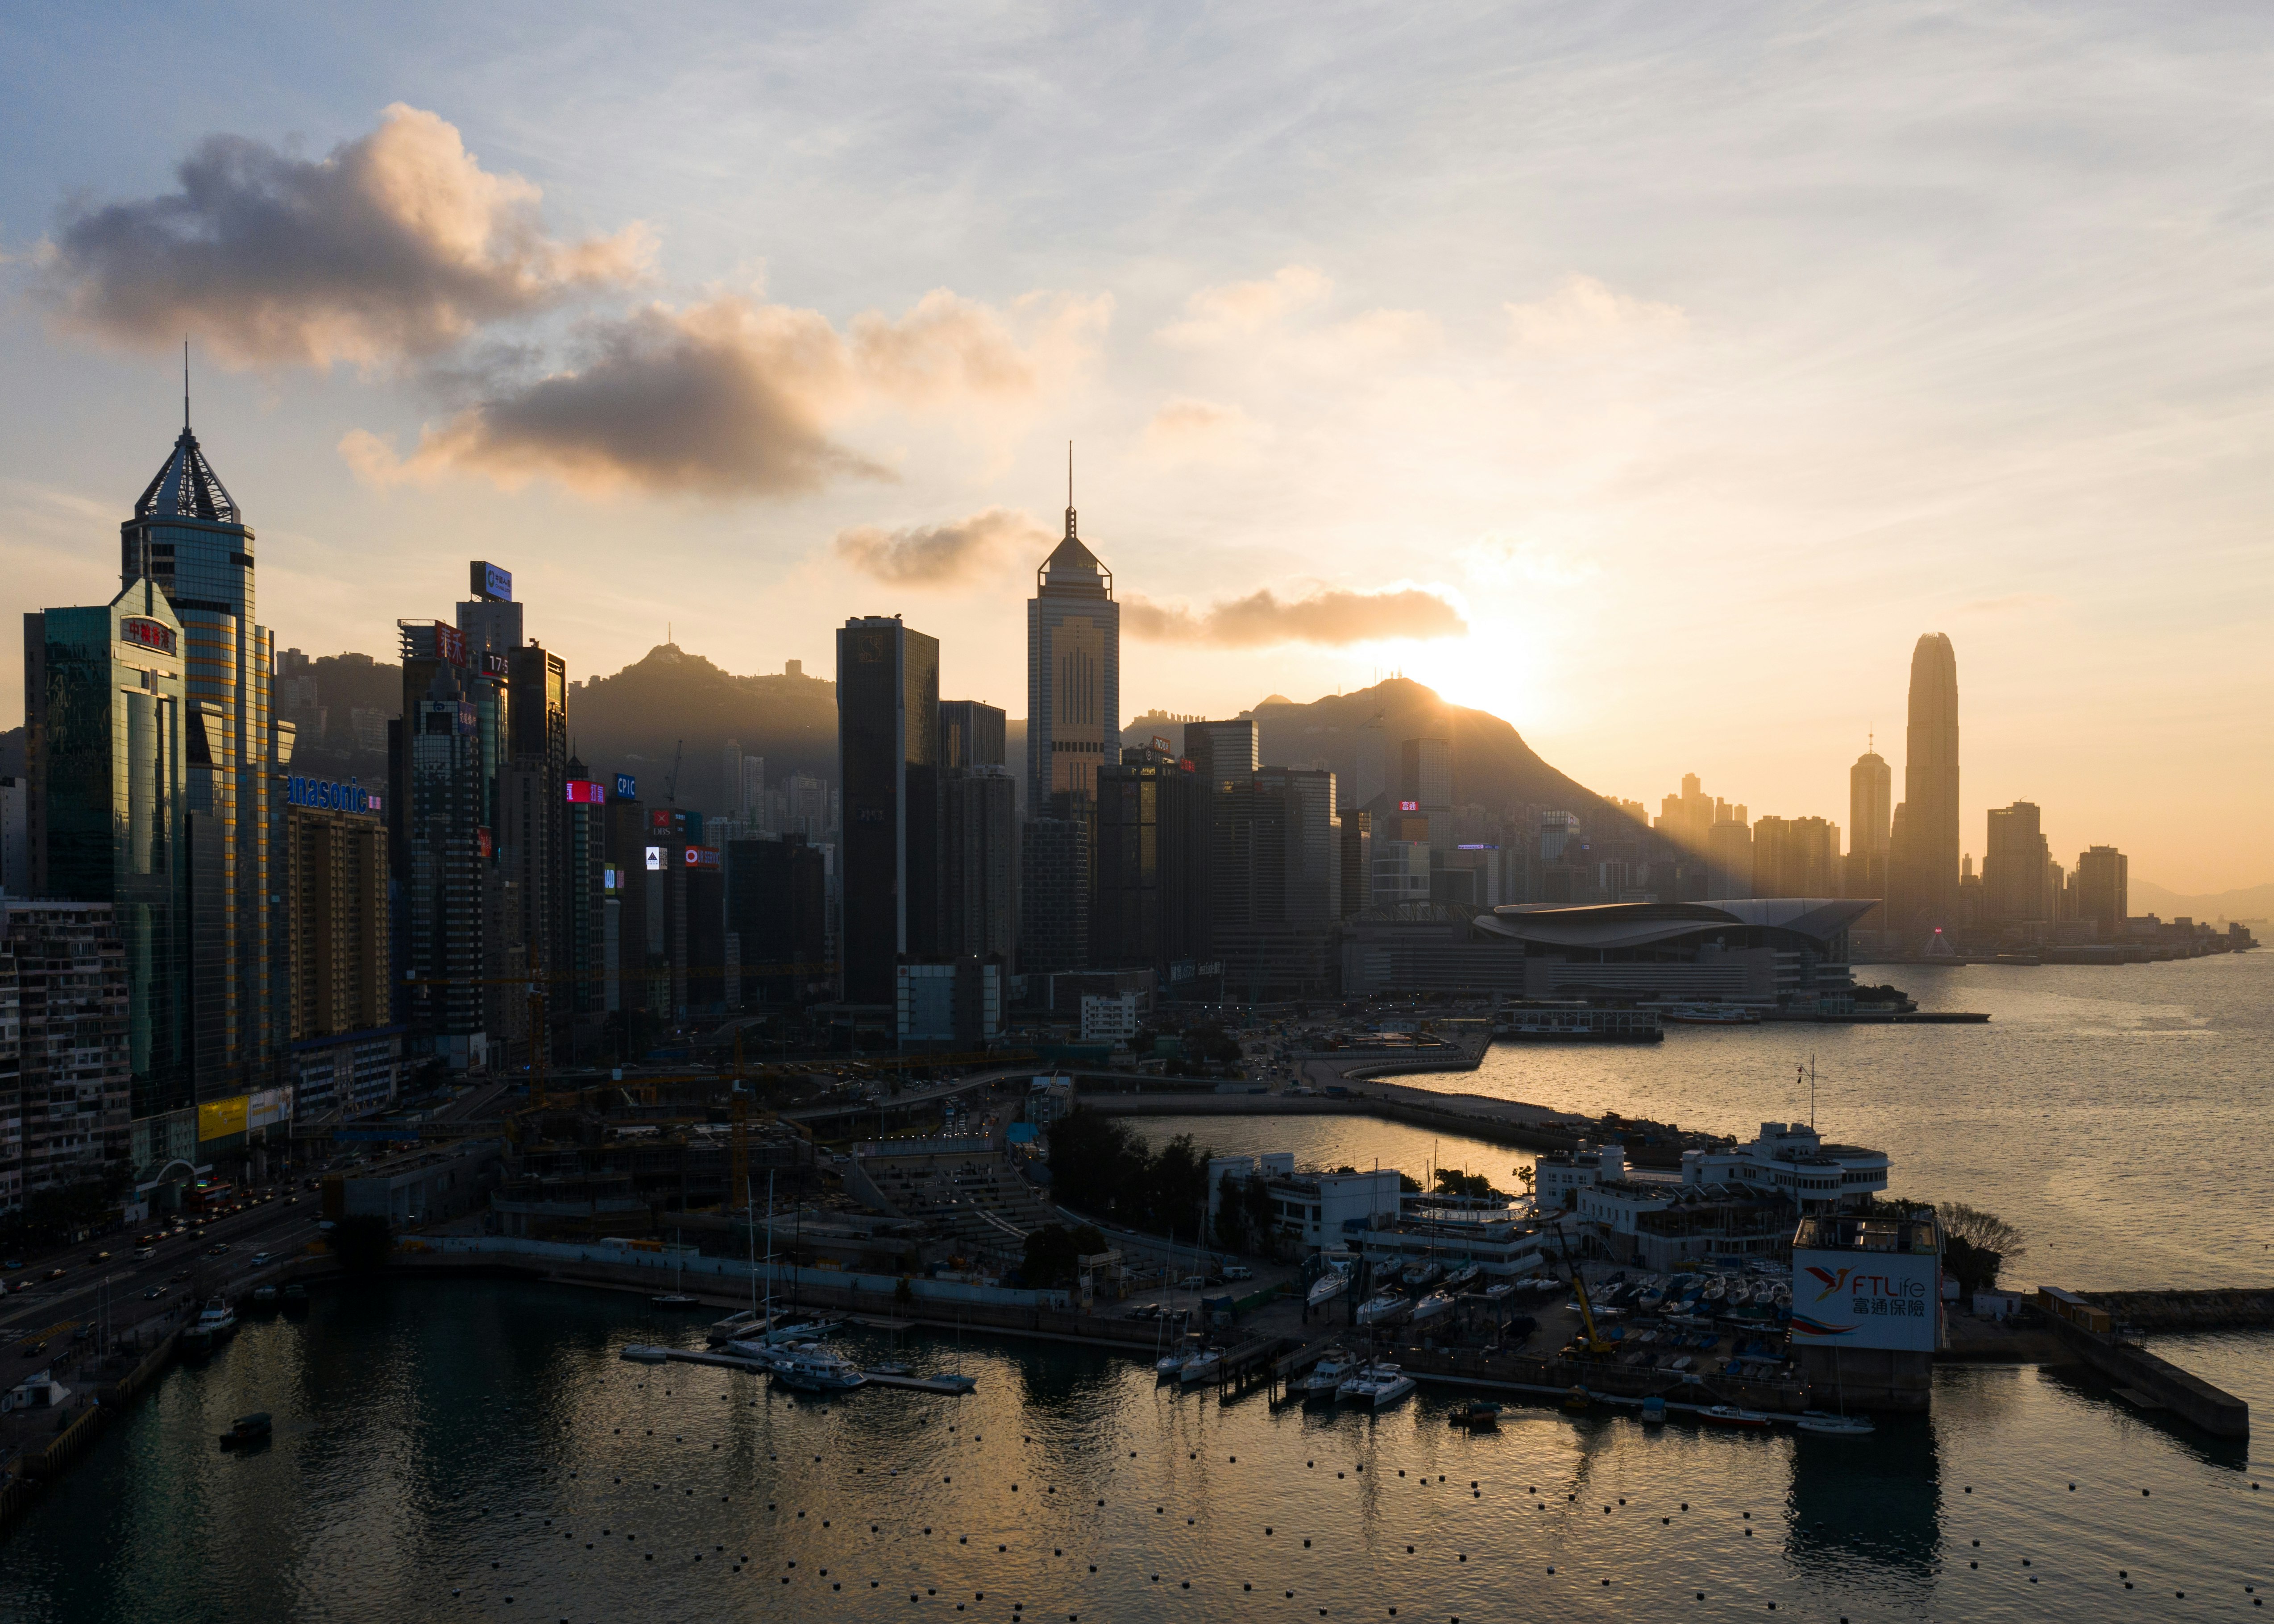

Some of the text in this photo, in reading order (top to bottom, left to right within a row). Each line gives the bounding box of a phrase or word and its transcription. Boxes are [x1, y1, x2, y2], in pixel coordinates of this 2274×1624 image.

[440, 626, 462, 663] 泰禾
[618, 778, 635, 795] CPIC
[1402, 801, 1416, 810] 富通
[1853, 1276, 1925, 1297] FTLife
[1853, 1297, 1925, 1317] 富通保險
